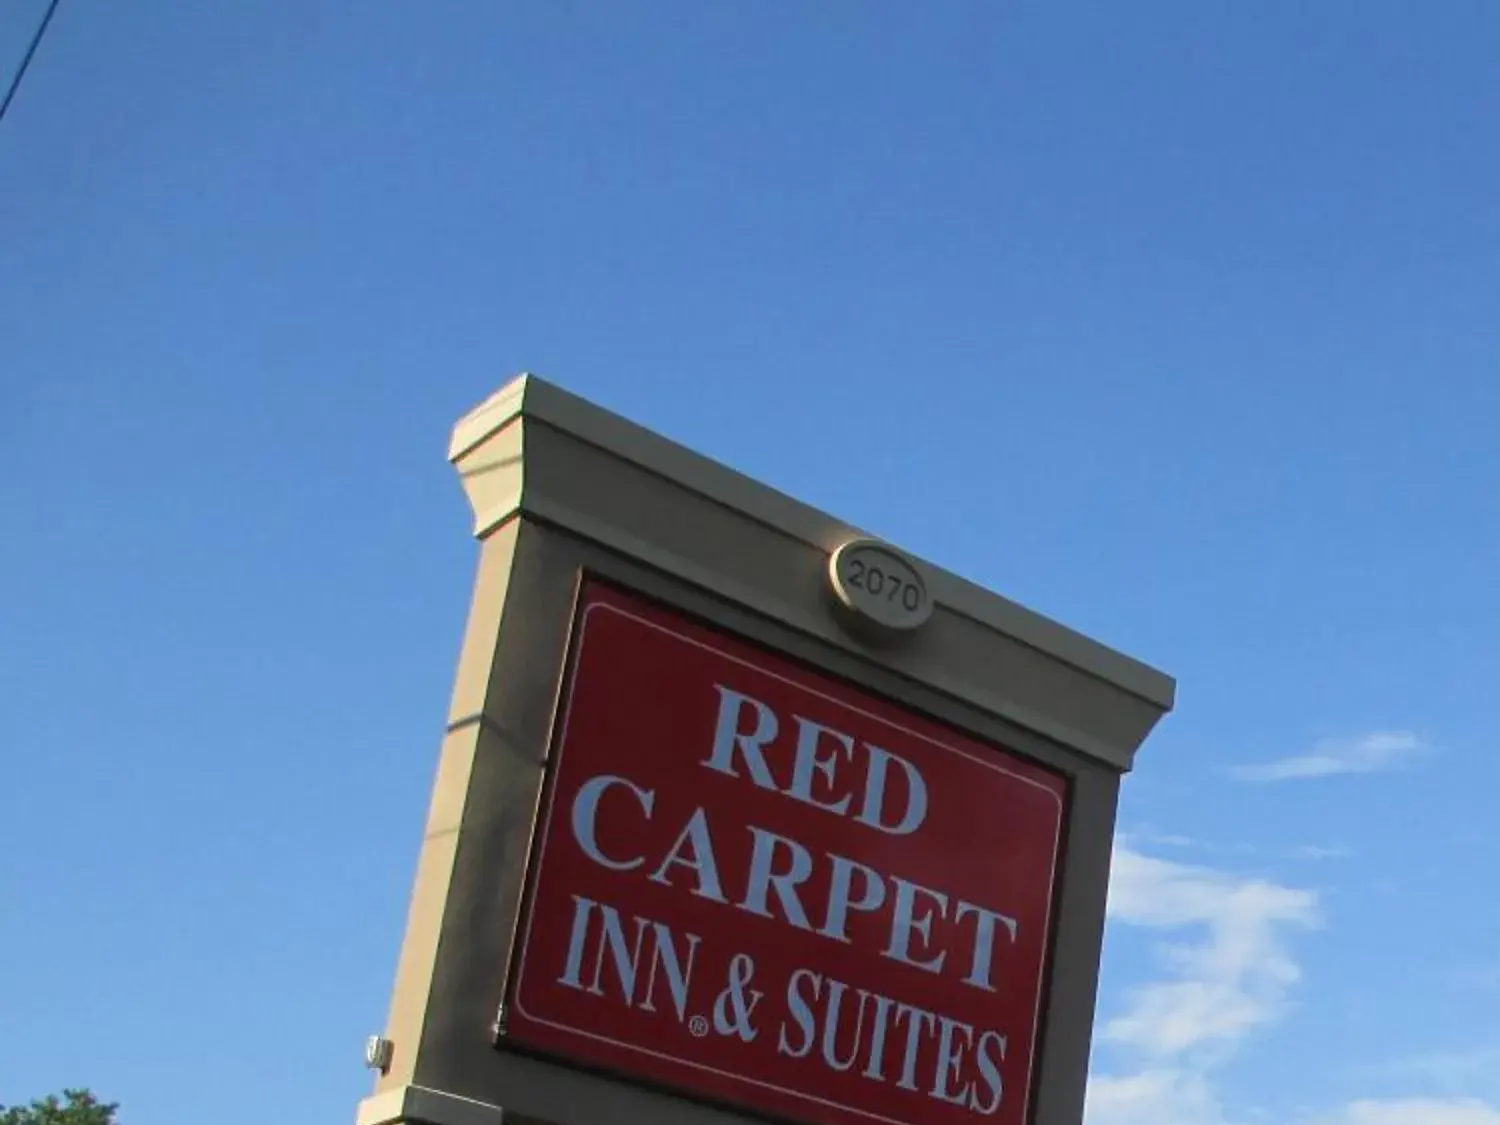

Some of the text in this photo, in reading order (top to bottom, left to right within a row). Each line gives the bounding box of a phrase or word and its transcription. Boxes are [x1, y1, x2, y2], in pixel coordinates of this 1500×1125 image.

[848, 559, 920, 612] 2070
[701, 684, 928, 836] RED
[571, 774, 1018, 993] CARPET
[713, 953, 764, 1043] &
[777, 969, 1007, 1117] SUITES
